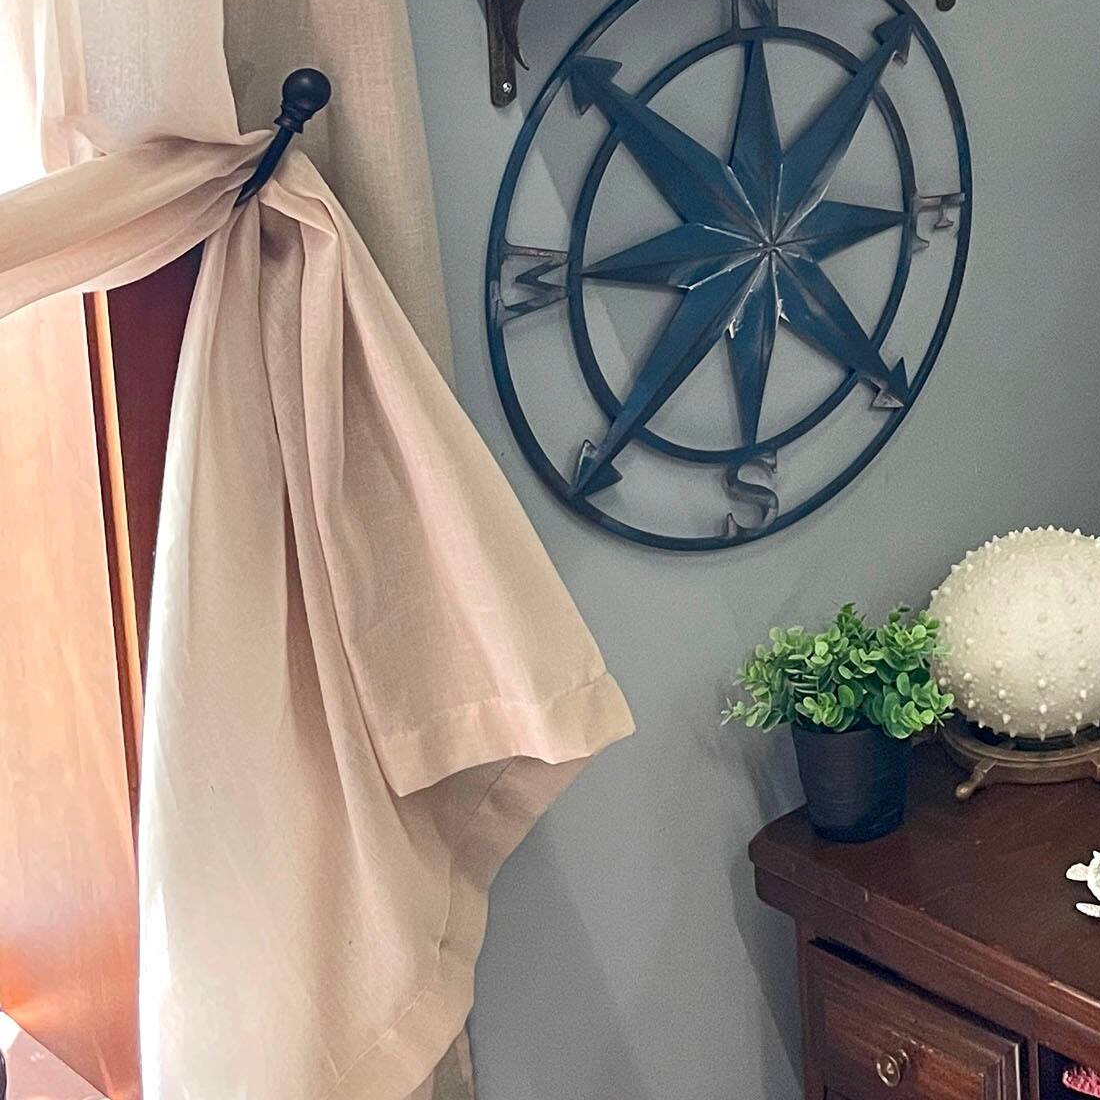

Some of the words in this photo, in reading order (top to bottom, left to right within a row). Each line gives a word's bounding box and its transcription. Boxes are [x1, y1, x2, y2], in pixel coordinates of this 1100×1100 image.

[910, 192, 965, 253] E
[497, 240, 569, 323] W
[726, 448, 779, 538] S
